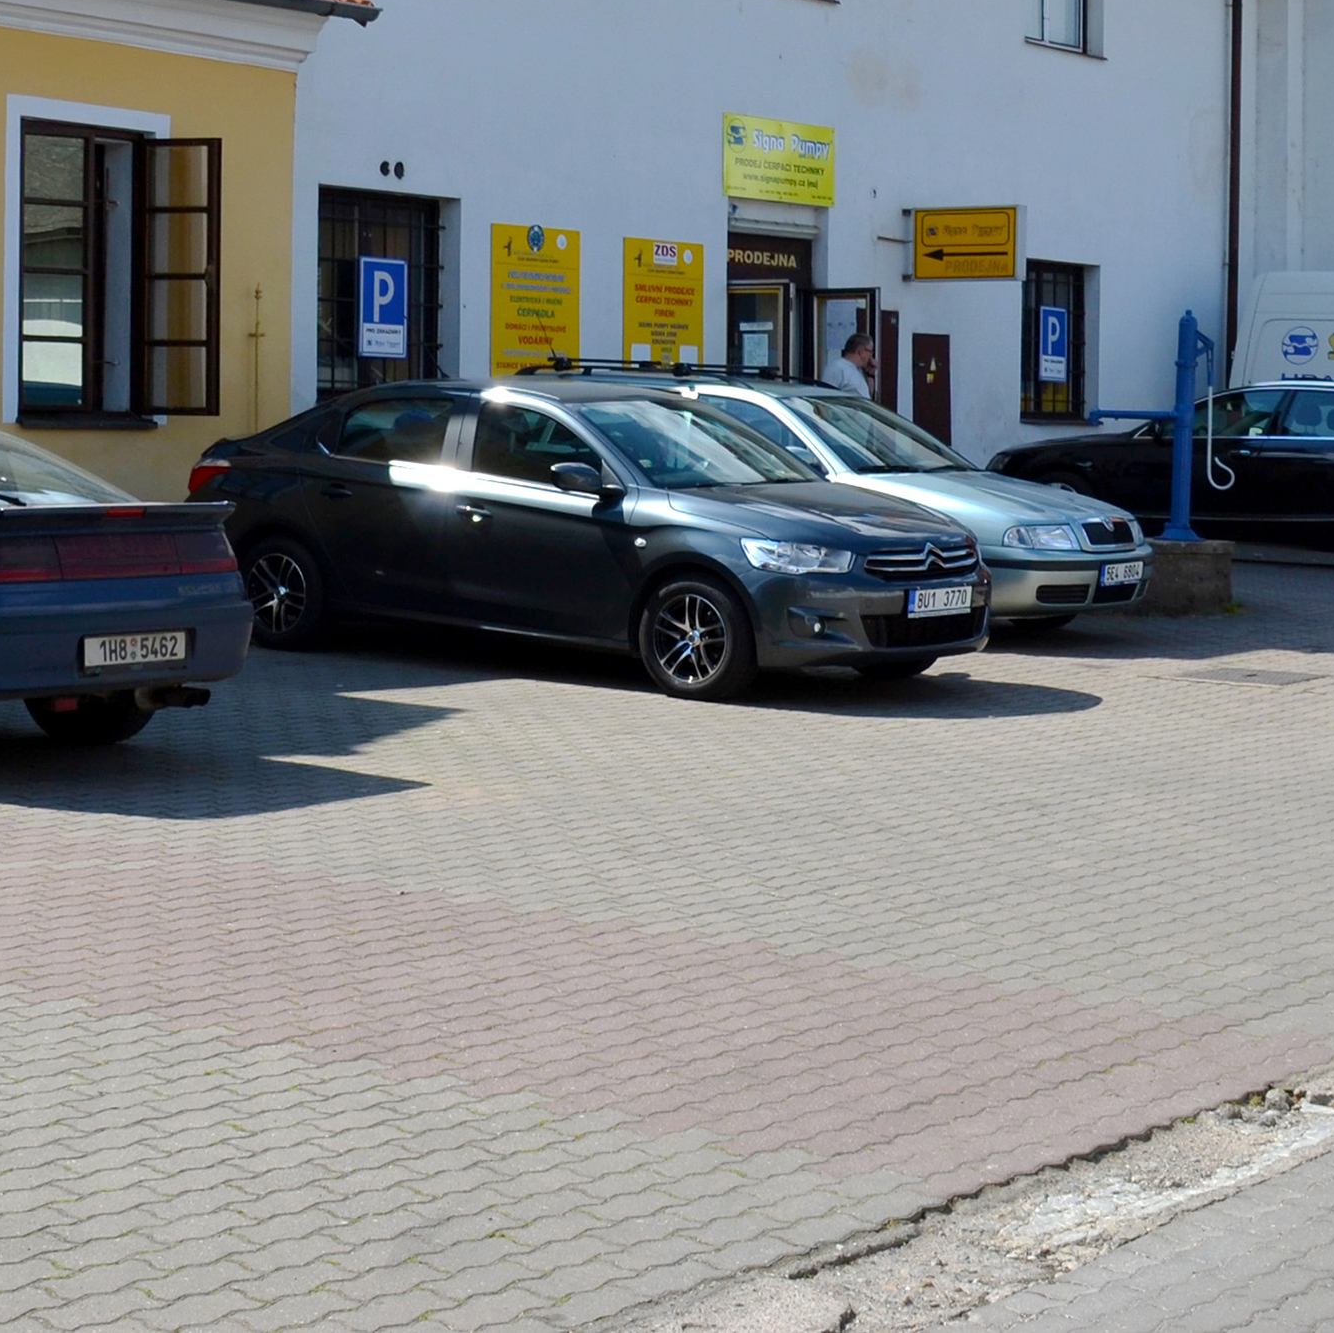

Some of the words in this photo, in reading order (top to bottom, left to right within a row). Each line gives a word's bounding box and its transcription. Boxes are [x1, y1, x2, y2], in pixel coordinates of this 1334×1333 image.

[752, 128, 785, 154] Signa
[790, 133, 830, 160] Pumpy
[734, 156, 762, 167] PRODEJ
[763, 159, 792, 172] ČERPACÍ
[793, 164, 825, 176] TECHNIKY
[742, 172, 806, 189] www.signapumpy.cz
[727, 248, 797, 268] PRODEJNA
[944, 259, 1009, 274] PRODEJNA
[373, 270, 395, 323] P
[634, 283, 663, 293] SMLUVNÍ
[664, 285, 695, 296] PRODEJCE
[1047, 315, 1061, 355] P
[917, 591, 937, 609] 8U1
[943, 589, 968, 607] 3770
[99, 639, 128, 662] 1H8
[139, 635, 178, 659] 5462
